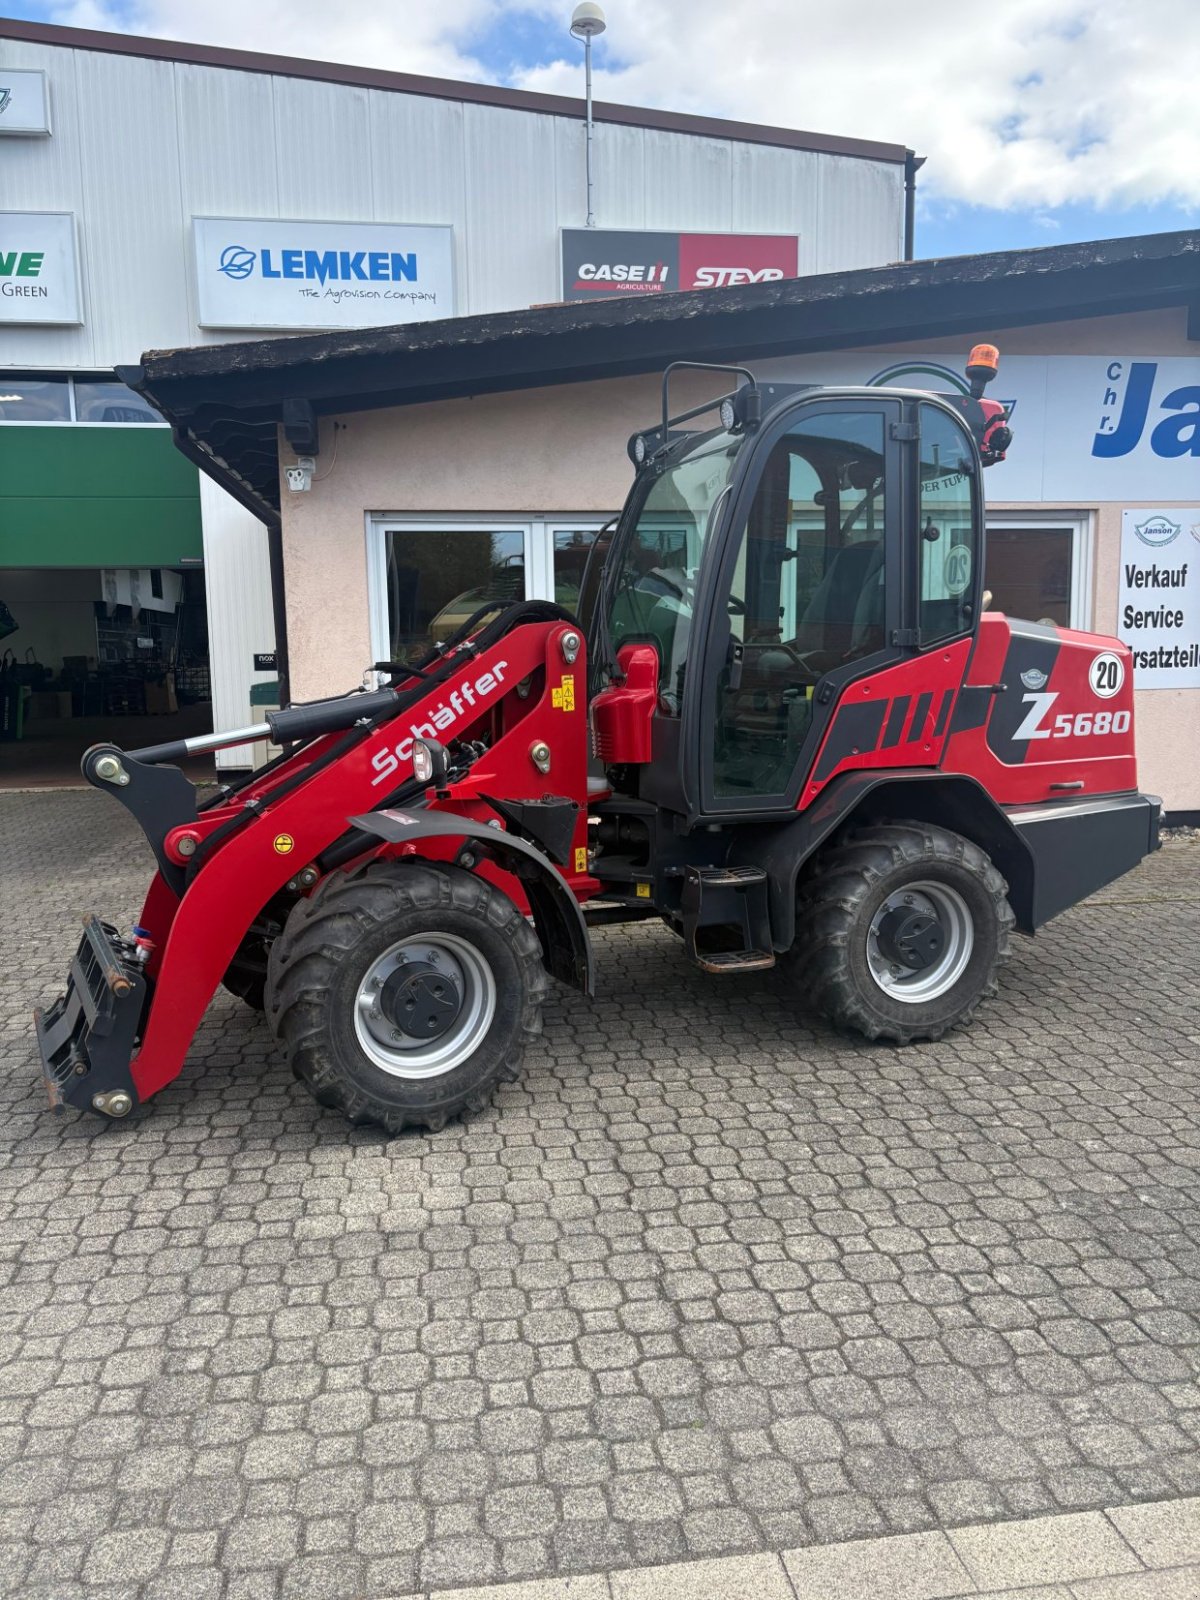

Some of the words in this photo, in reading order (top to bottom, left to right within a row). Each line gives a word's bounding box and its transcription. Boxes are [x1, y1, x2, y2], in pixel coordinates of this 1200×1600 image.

[261, 249, 418, 287] LEMKEN
[578, 263, 645, 281] CASE
[299, 288, 321, 298] The
[323, 288, 381, 304] Agrovision
[383, 290, 437, 304] Company
[616, 283, 662, 291] AGRICULTURE
[1143, 527, 1173, 535] Janson
[1125, 563, 1188, 588] Verkauf
[1123, 604, 1184, 629] Service
[1128, 644, 1200, 669] rsatzteil
[1096, 661, 1118, 690] 20
[371, 660, 508, 787] Schäffer
[1053, 710, 1131, 738] 5680
